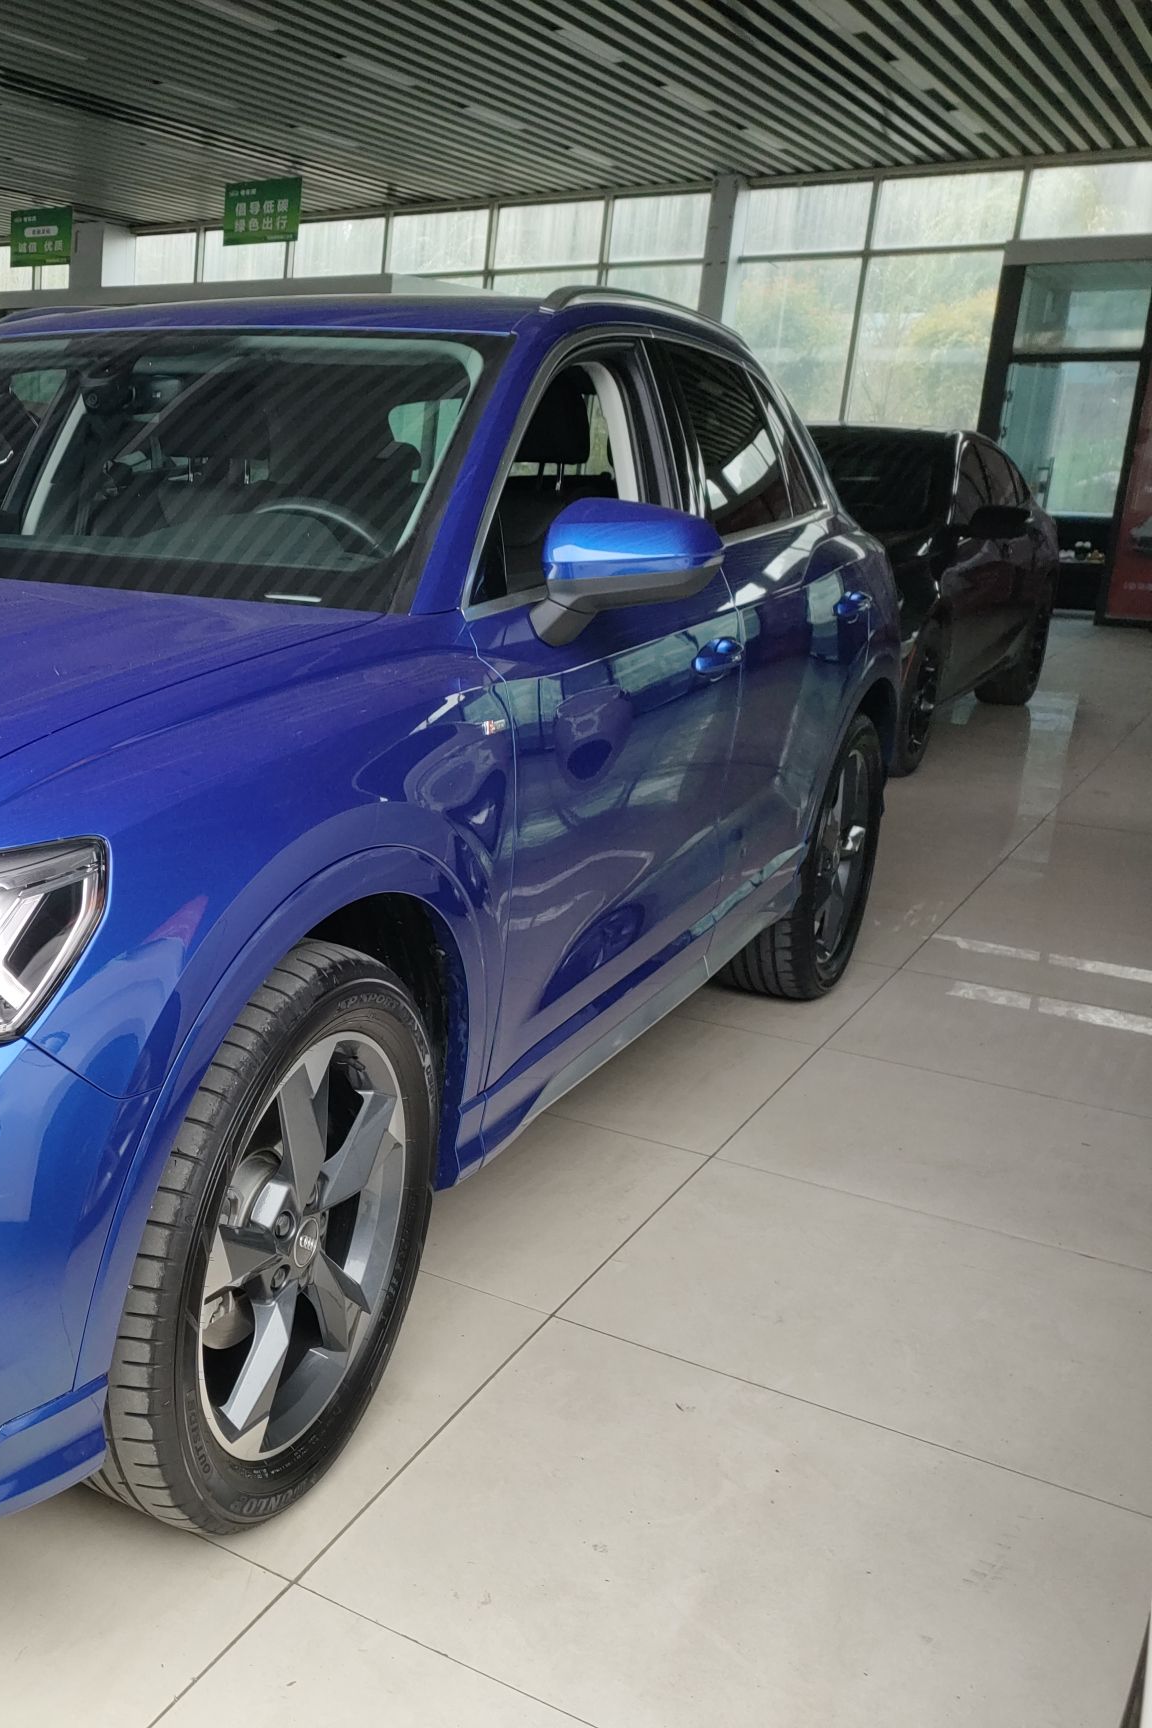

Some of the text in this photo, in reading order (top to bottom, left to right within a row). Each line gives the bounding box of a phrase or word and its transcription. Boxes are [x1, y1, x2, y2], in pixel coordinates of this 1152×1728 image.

[235, 199, 289, 217] 倡导低碳
[234, 215, 288, 233] 绿色出行
